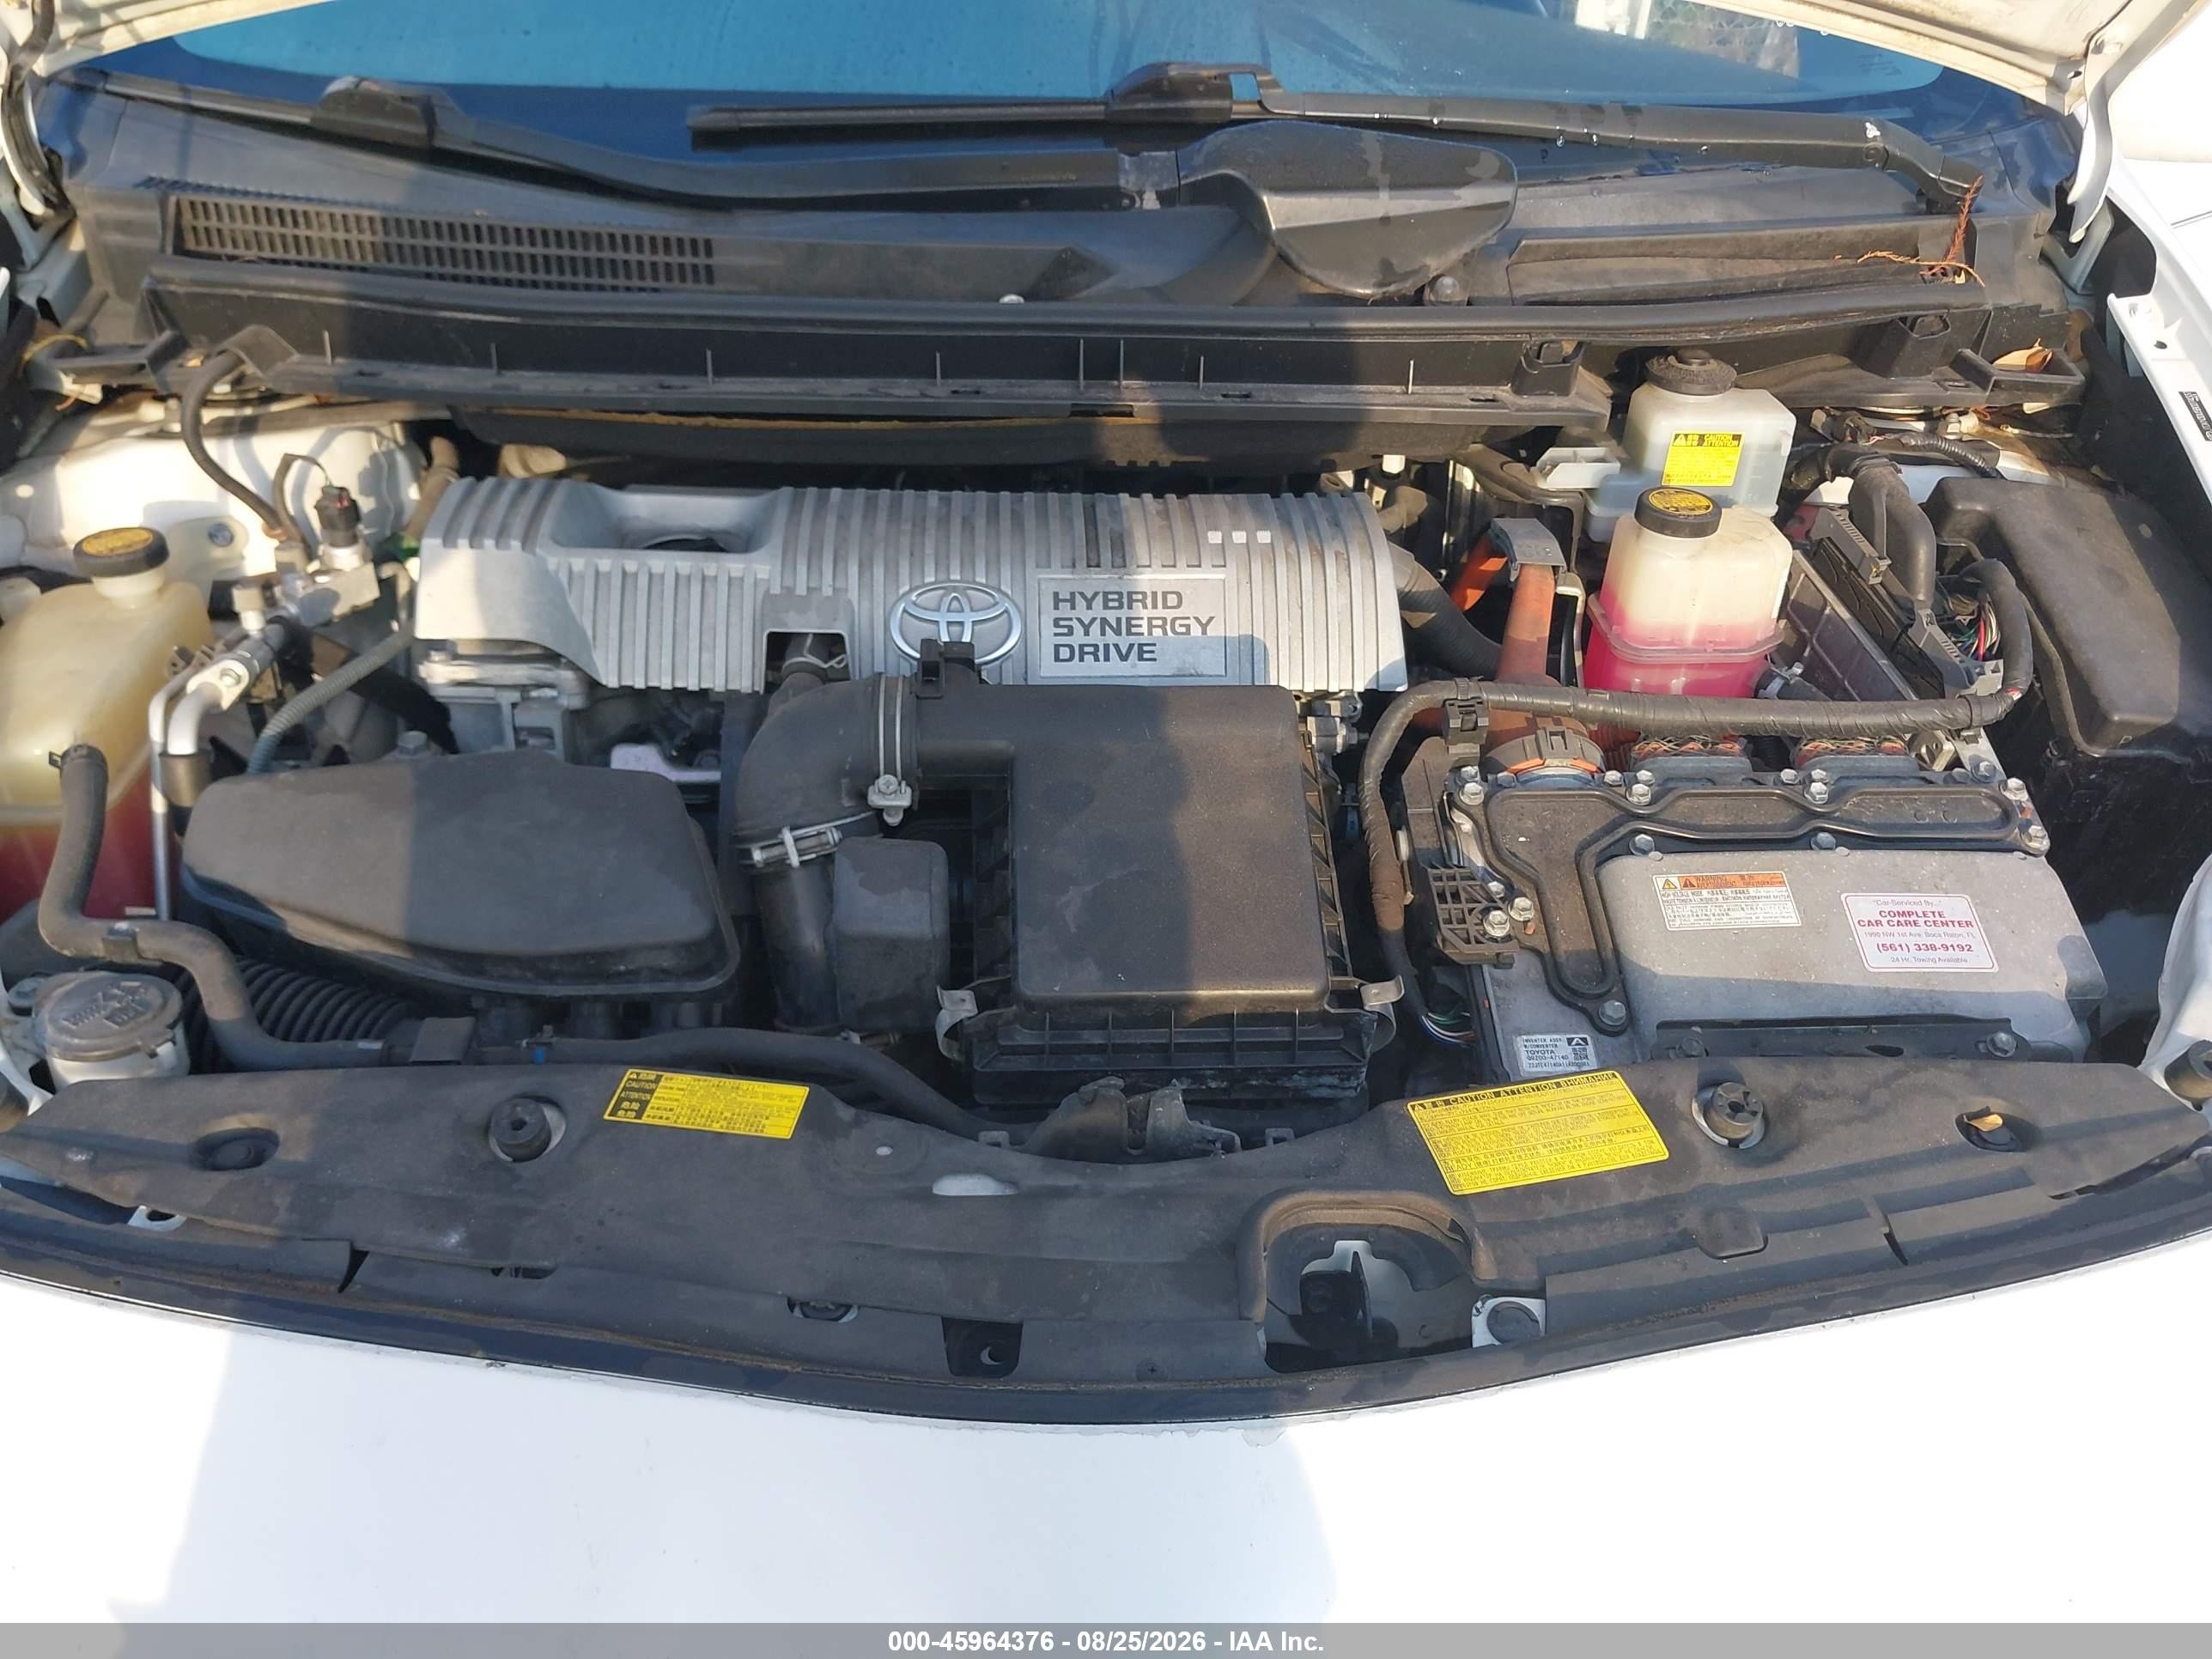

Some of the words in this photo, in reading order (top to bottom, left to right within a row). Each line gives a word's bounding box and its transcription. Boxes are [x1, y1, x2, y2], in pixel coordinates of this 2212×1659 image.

[1053, 591, 1183, 611] HYBRID
[1053, 616, 1215, 636] SYNERGY
[1053, 642, 1158, 663] DRIVE
[1879, 910, 1947, 919] COMPLETE
[1857, 919, 1883, 927] CAR
[1887, 919, 1920, 927] CARE
[1923, 920, 1974, 928] CENTER
[1876, 943, 1911, 953] (561)
[1914, 943, 1974, 952] 338-9192
[1912, 956, 1937, 964] Towing
[625, 1080, 657, 1090] CAUTION
[1560, 1073, 1615, 1089] ВНИМАНИЕ
[1449, 1091, 1495, 1105] CAUTION
[1499, 1082, 1557, 1098] ATTENTION
